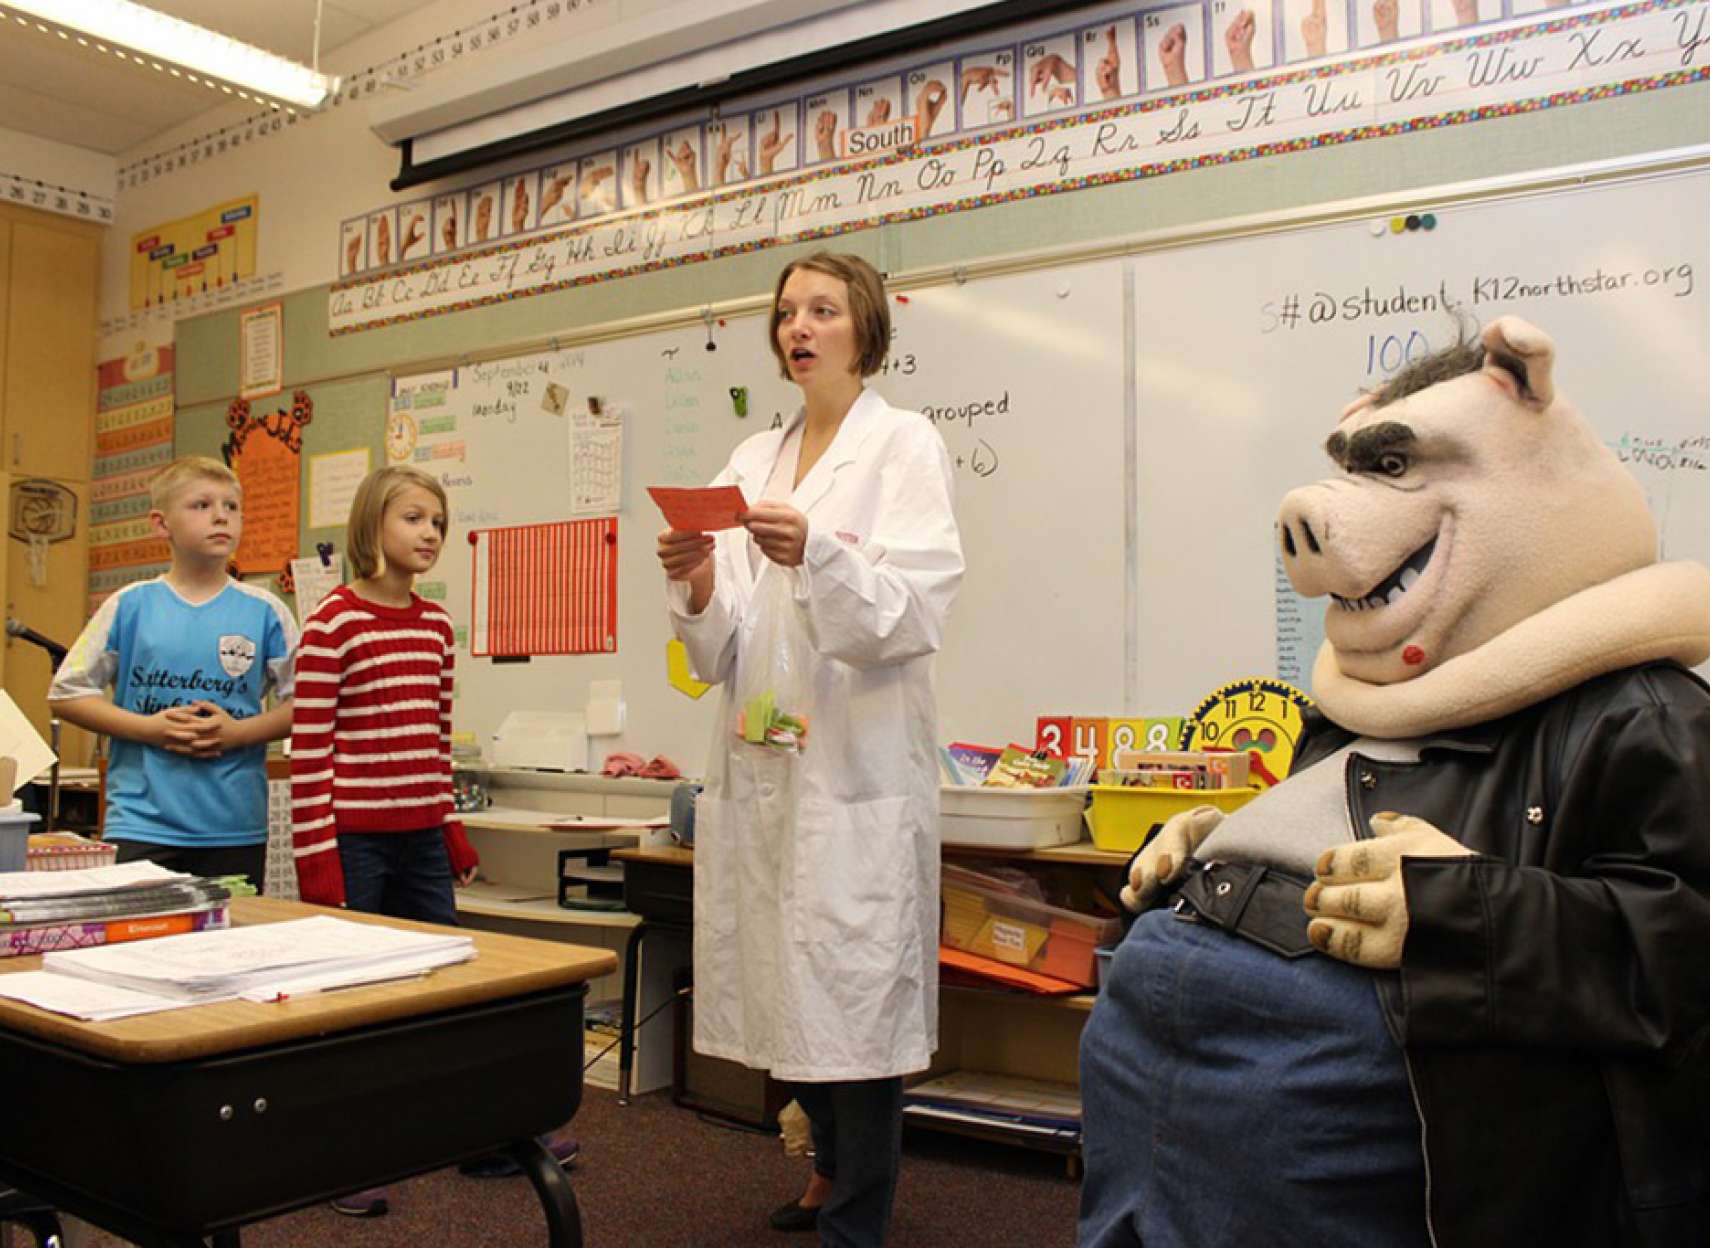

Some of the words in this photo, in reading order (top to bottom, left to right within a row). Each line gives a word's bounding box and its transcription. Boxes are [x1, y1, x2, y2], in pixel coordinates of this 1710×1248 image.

[994, 53, 1012, 66] Pp
[909, 71, 926, 84] Oo
[779, 188, 842, 221] Mm
[856, 172, 903, 204] Nn
[916, 158, 956, 191] Oo
[972, 147, 1007, 191] Pp
[1092, 122, 1140, 157] Rr
[1155, 108, 1202, 147] Ss
[1304, 81, 1363, 118] Uu
[1385, 61, 1447, 103] Vv
[1466, 46, 1545, 87] Ww
[1567, 28, 1646, 72] Xx
[849, 122, 913, 155] South
[1366, 330, 1430, 375] 100
[1225, 699, 1238, 719] 11
[1249, 691, 1267, 713] 12
[1280, 699, 1289, 720] 1
[1200, 720, 1220, 742] 10
[1040, 723, 1063, 757] 3
[1074, 725, 1100, 758] 4
[1112, 726, 1135, 772] 8
